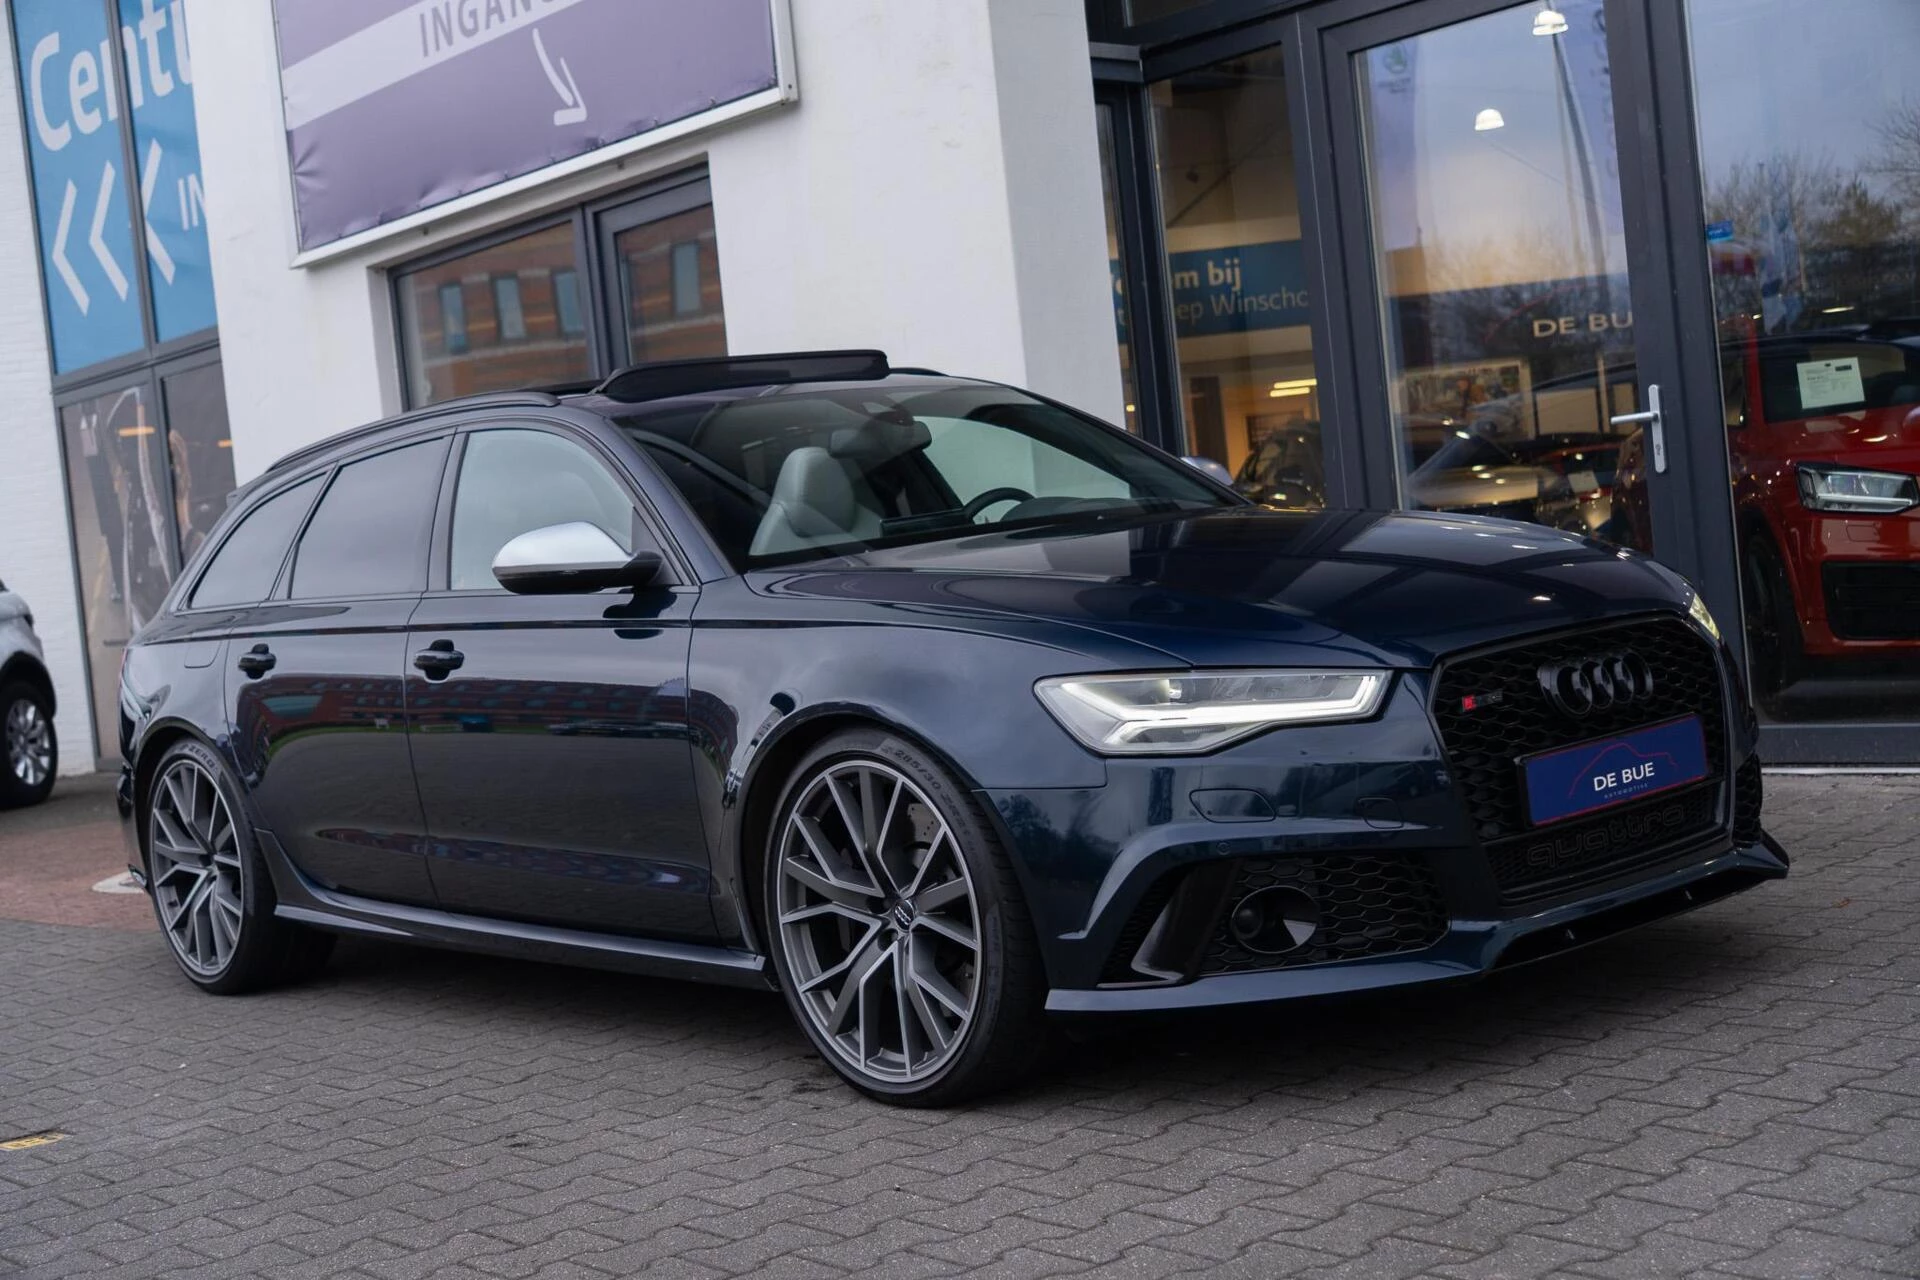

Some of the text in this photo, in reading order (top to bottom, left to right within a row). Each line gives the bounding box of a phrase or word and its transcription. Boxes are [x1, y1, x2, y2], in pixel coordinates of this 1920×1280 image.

[420, 0, 554, 57] INGA
[1207, 258, 1241, 292] bij
[1532, 311, 1633, 338] DE BU
[1593, 762, 1655, 791] DE BUE
[1527, 804, 1685, 869] quattro
